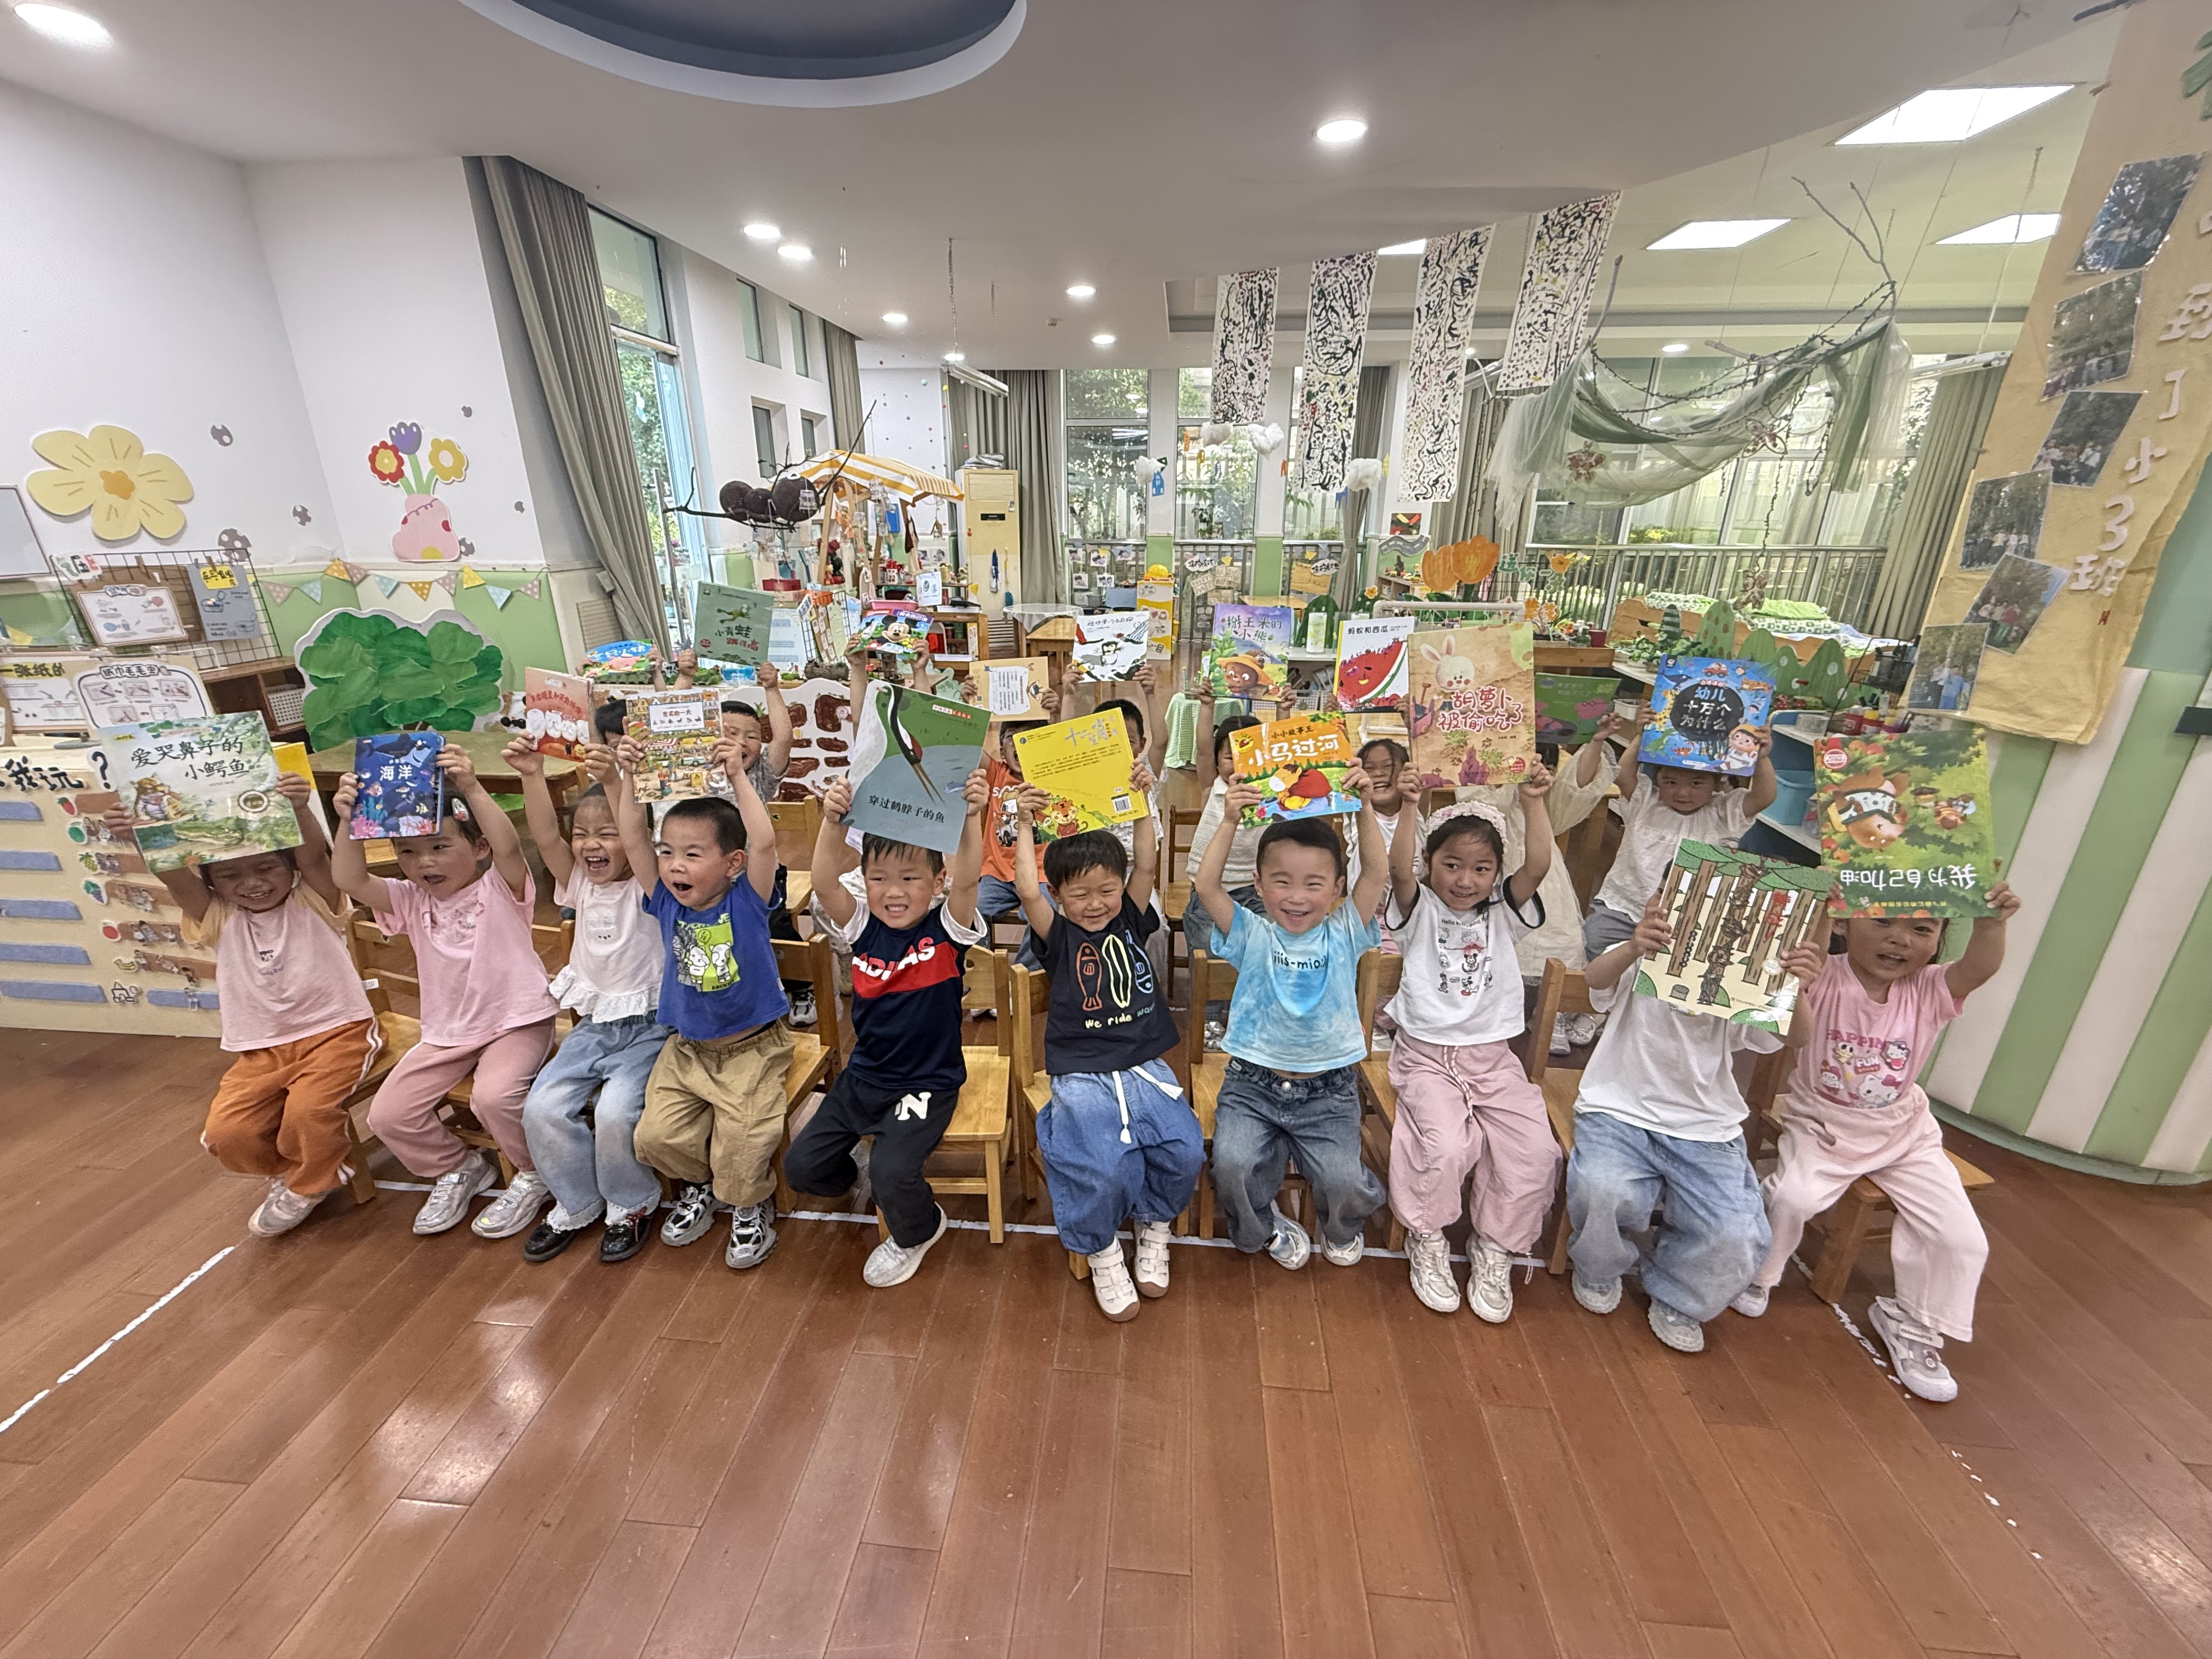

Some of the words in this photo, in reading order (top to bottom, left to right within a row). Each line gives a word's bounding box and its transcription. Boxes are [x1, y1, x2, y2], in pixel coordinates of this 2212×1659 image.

[2069, 210, 2212, 596] 到了小3班
[715, 624, 752, 639] 小青蛙
[1238, 629, 1267, 644] 小熊
[1347, 625, 1388, 635] 蚂蚁和西瓜
[102, 665, 159, 678] 纸巾毛毛虫
[1452, 686, 1513, 710] 胡萝卜
[1694, 687, 1726, 702] 幼儿
[1437, 703, 1523, 733] 被偷吃了
[1684, 701, 1731, 716] 十万个
[1271, 725, 1314, 739] 小小故事王
[1680, 714, 1727, 730] 为什么
[131, 737, 243, 769] 爱哭鼻子的
[1248, 733, 1339, 766] 小马过河
[185, 758, 250, 780] 小鳄鱼
[379, 765, 413, 781] 海洋
[869, 794, 945, 823] 穿过鹤脖子的鱼
[1840, 863, 1978, 891] 我为自己加油
[851, 936, 935, 981] ADIAS
[1085, 1019, 1102, 1029] We
[1107, 1013, 1133, 1026] ride
[1136, 1003, 1155, 1018] wav
[1855, 1056, 1880, 1068] FUN
[898, 1091, 932, 1121] N
